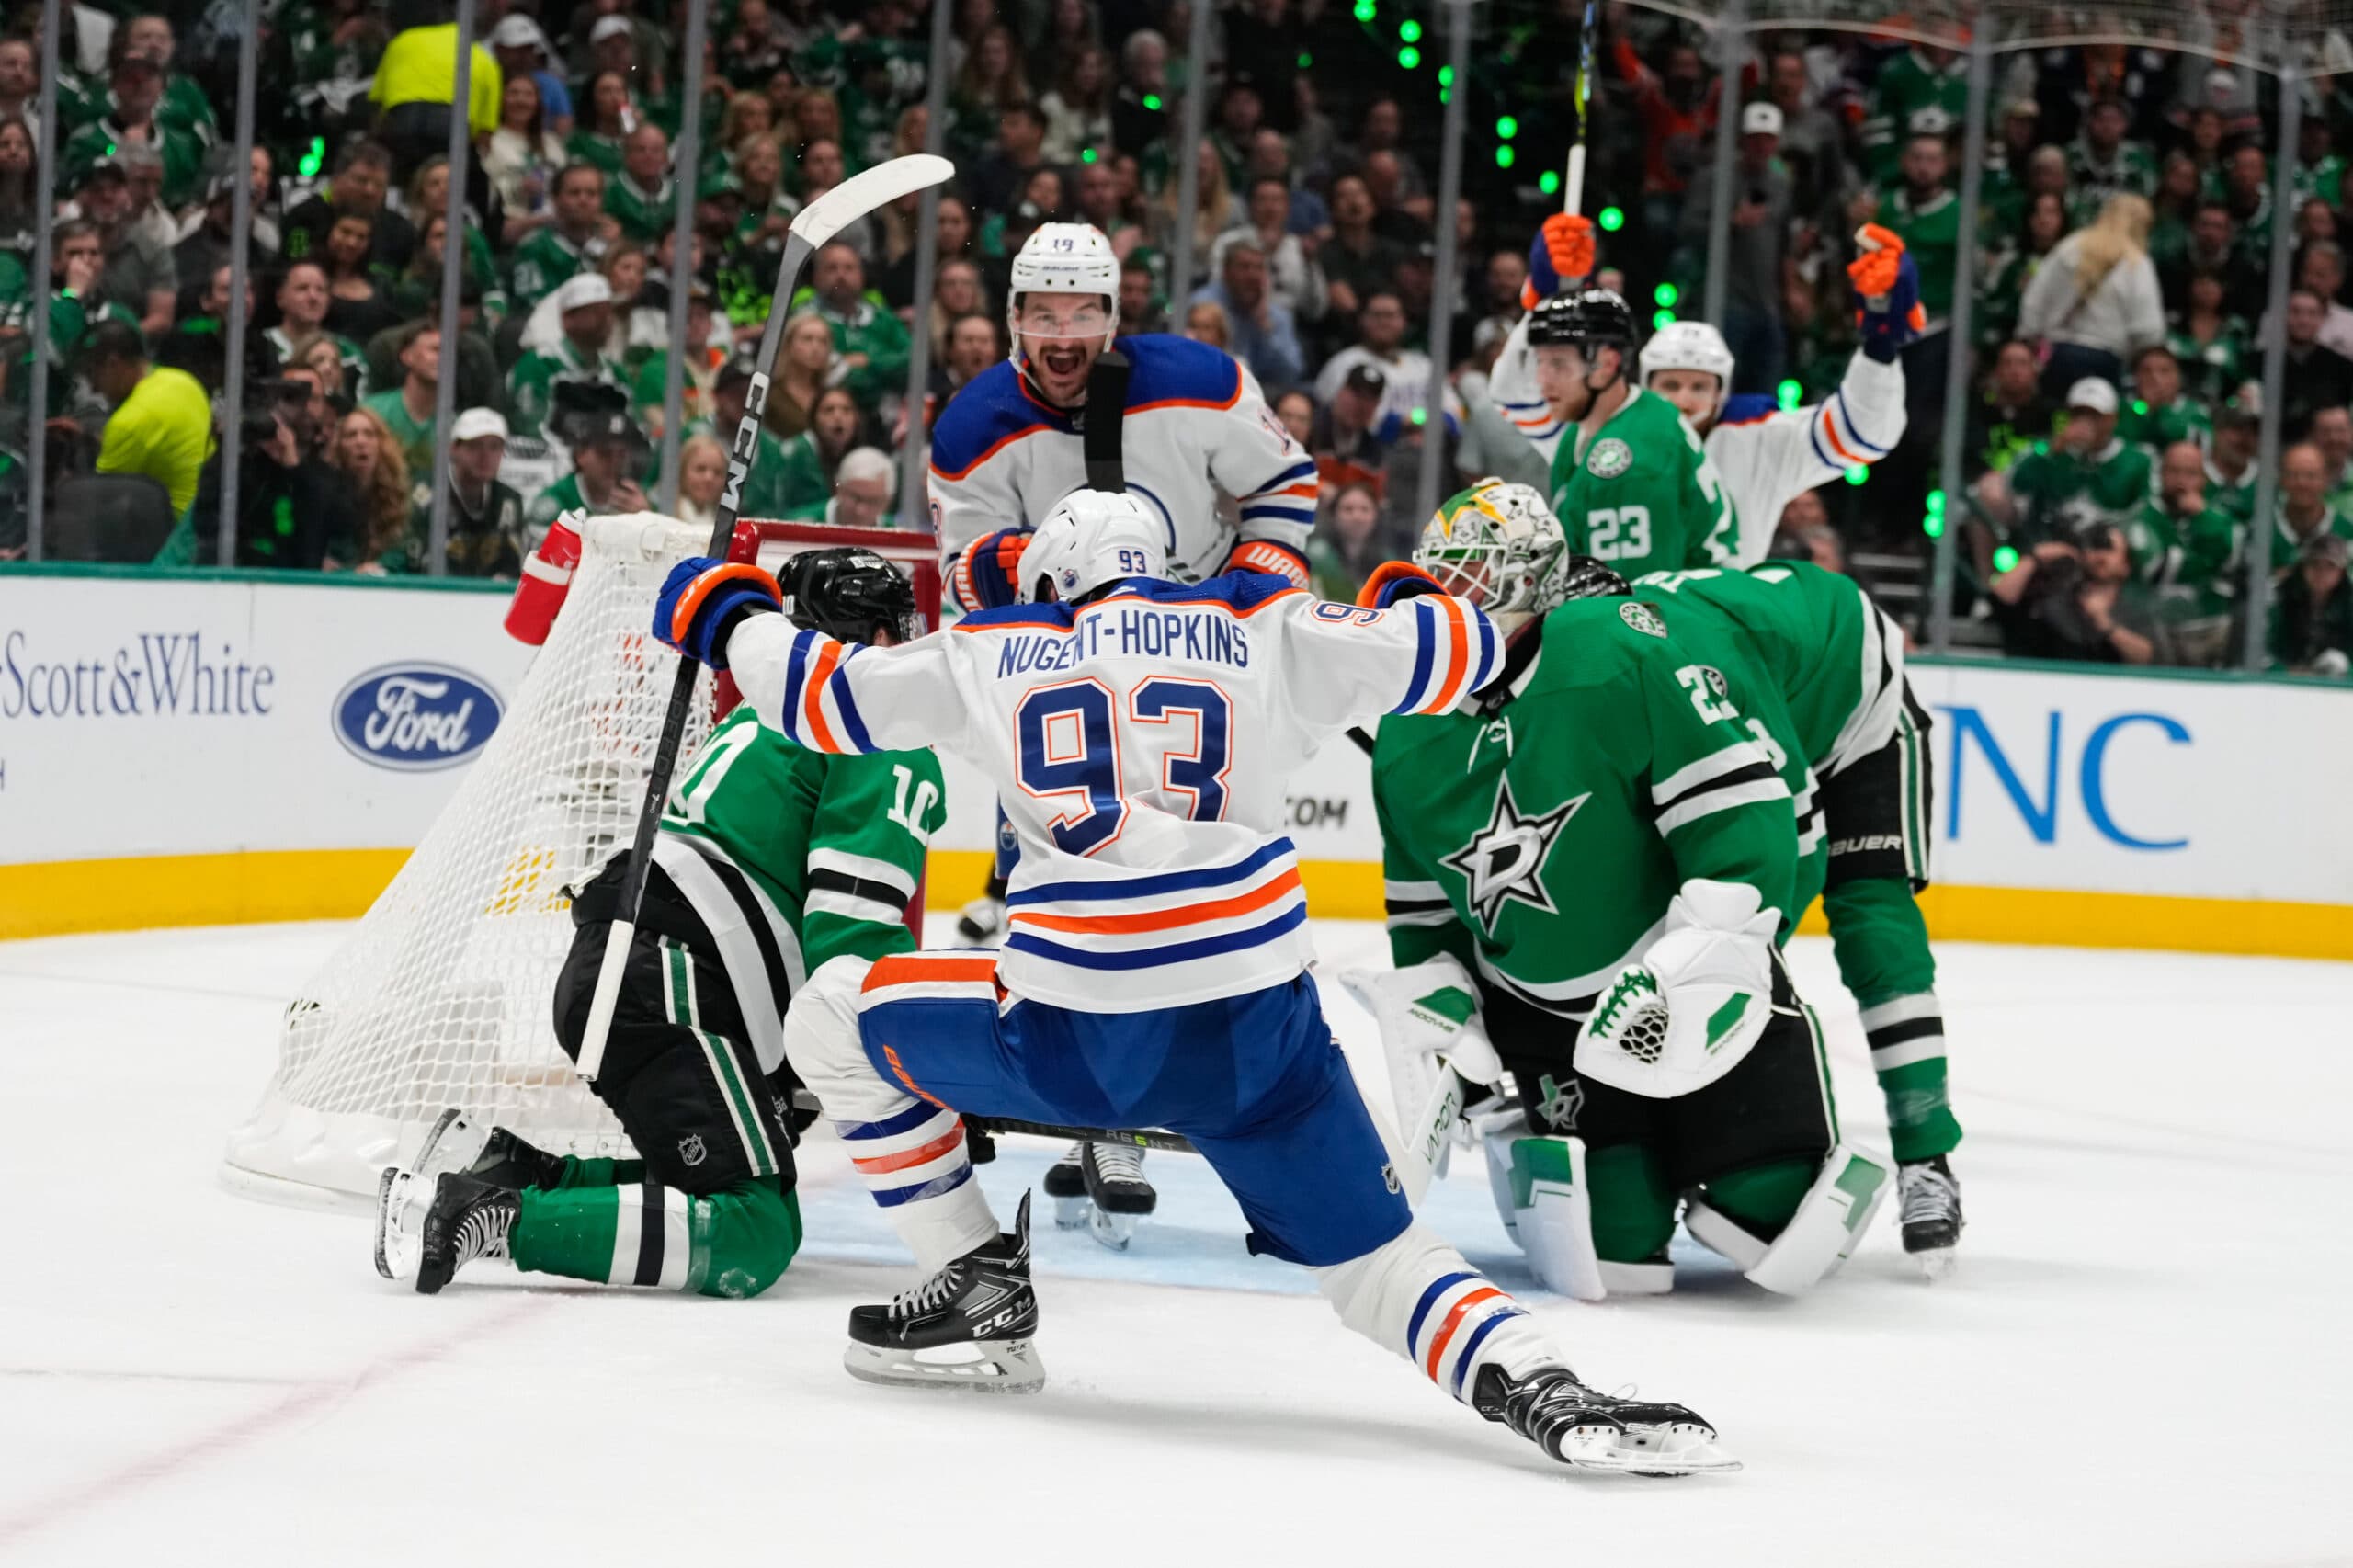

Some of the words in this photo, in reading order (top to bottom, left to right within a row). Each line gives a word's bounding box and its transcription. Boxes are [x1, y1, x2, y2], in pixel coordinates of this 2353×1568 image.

[721, 370, 770, 512] CCM
[1119, 550, 1147, 574] 93
[1587, 505, 1652, 562] 23
[997, 608, 1248, 679] NUGENT-HOPKINS
[365, 676, 475, 752] Ford
[1014, 675, 1234, 858] 93
[887, 764, 938, 846] 10
[1828, 835, 1903, 857] AUER
[1422, 1091, 1457, 1164] VAPOR
